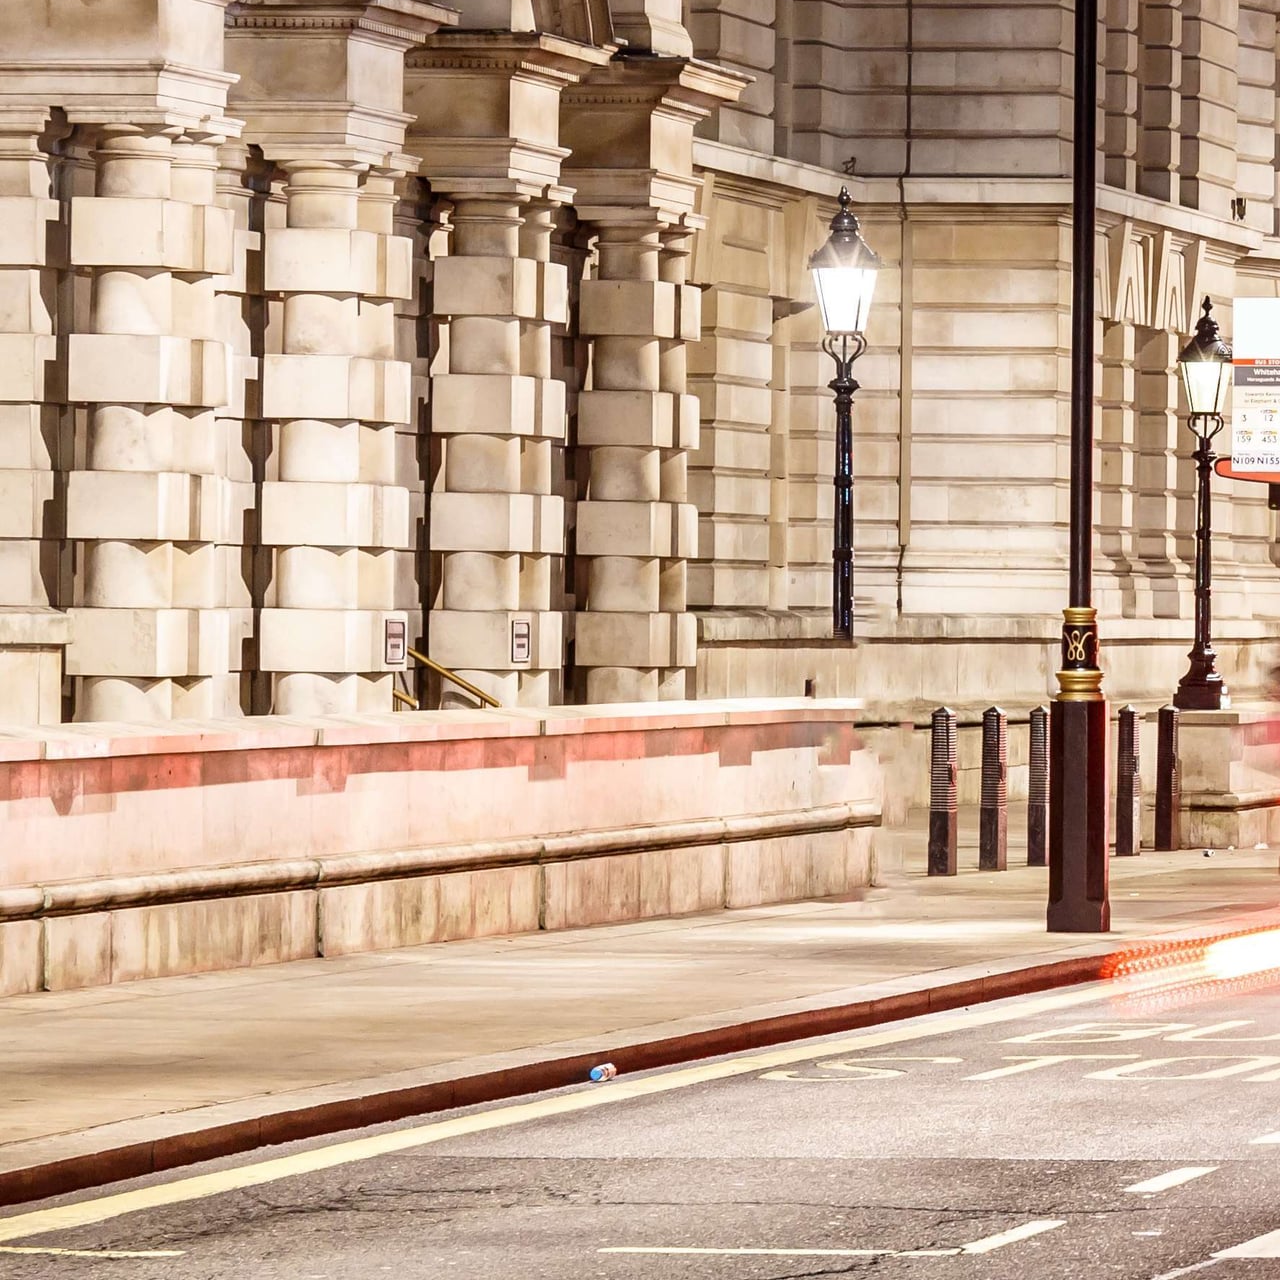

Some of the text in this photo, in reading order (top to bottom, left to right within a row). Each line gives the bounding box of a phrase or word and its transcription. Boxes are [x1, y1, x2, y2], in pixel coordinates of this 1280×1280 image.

[1242, 414, 1247, 422] 3
[1264, 414, 1274, 422] 12
[1236, 435, 1252, 443] 159
[1261, 435, 1278, 443] 453
[1232, 456, 1255, 465] N109
[1257, 456, 1280, 465] N155
